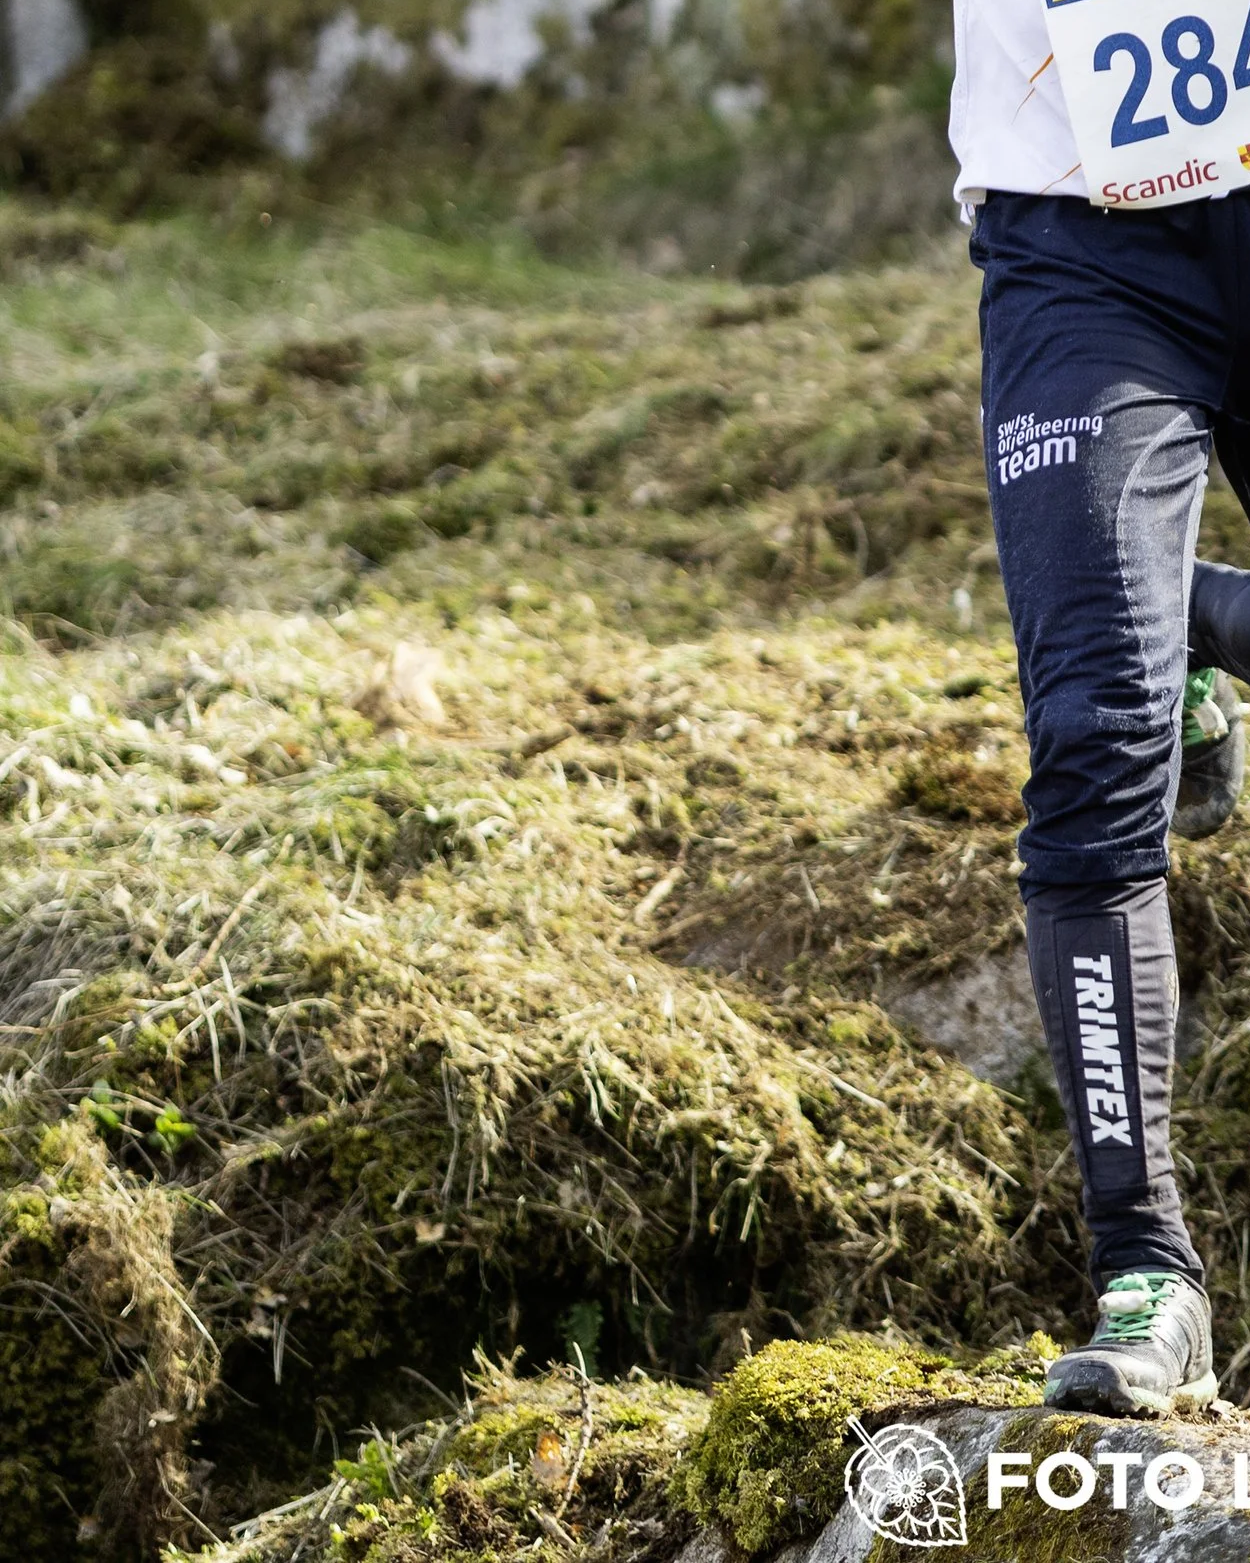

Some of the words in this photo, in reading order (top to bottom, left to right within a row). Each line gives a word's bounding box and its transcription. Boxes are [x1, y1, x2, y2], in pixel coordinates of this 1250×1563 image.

[1102, 159, 1219, 205] Scandic
[998, 413, 1034, 440] swiss
[998, 415, 1103, 455] orienteering
[998, 436, 1077, 485] team
[1073, 954, 1133, 1147] TRIMTEX
